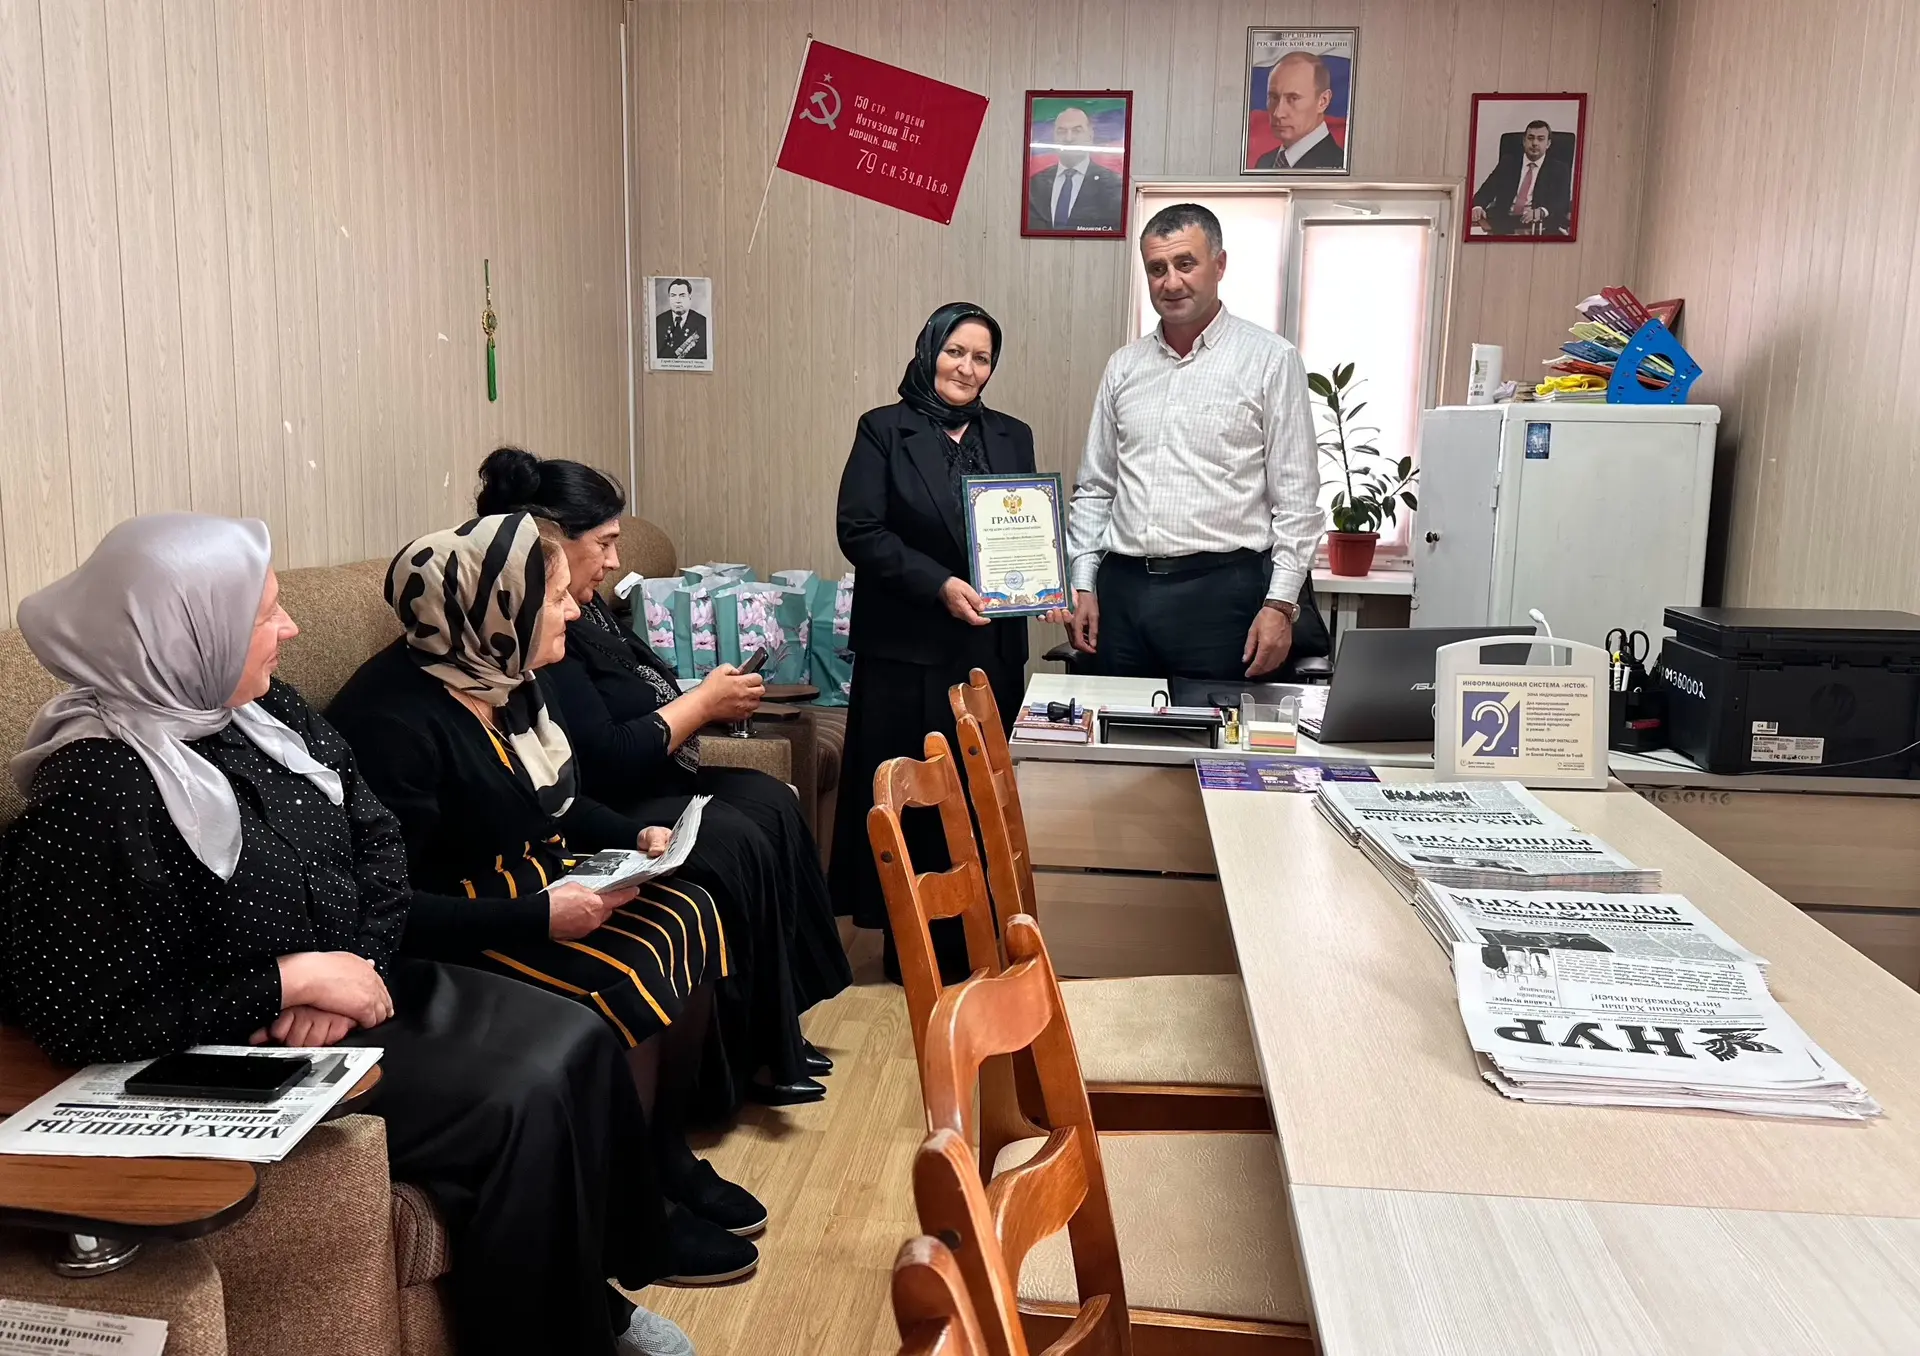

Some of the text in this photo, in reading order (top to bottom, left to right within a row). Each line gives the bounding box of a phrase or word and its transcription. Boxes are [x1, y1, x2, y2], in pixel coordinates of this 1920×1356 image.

[854, 95, 869, 110] 150
[894, 111, 926, 128] ОРДЕНА
[856, 148, 878, 174] 79
[991, 515, 1037, 524] ГРАМОТА
[1410, 682, 1436, 690] ASU
[1462, 680, 1527, 688] ИНФОРМАЦИОННАЯ
[1529, 681, 1560, 689] СИСТЕМА
[1493, 1017, 1698, 1060] НУР
[52, 1107, 157, 1120] хабарбыр
